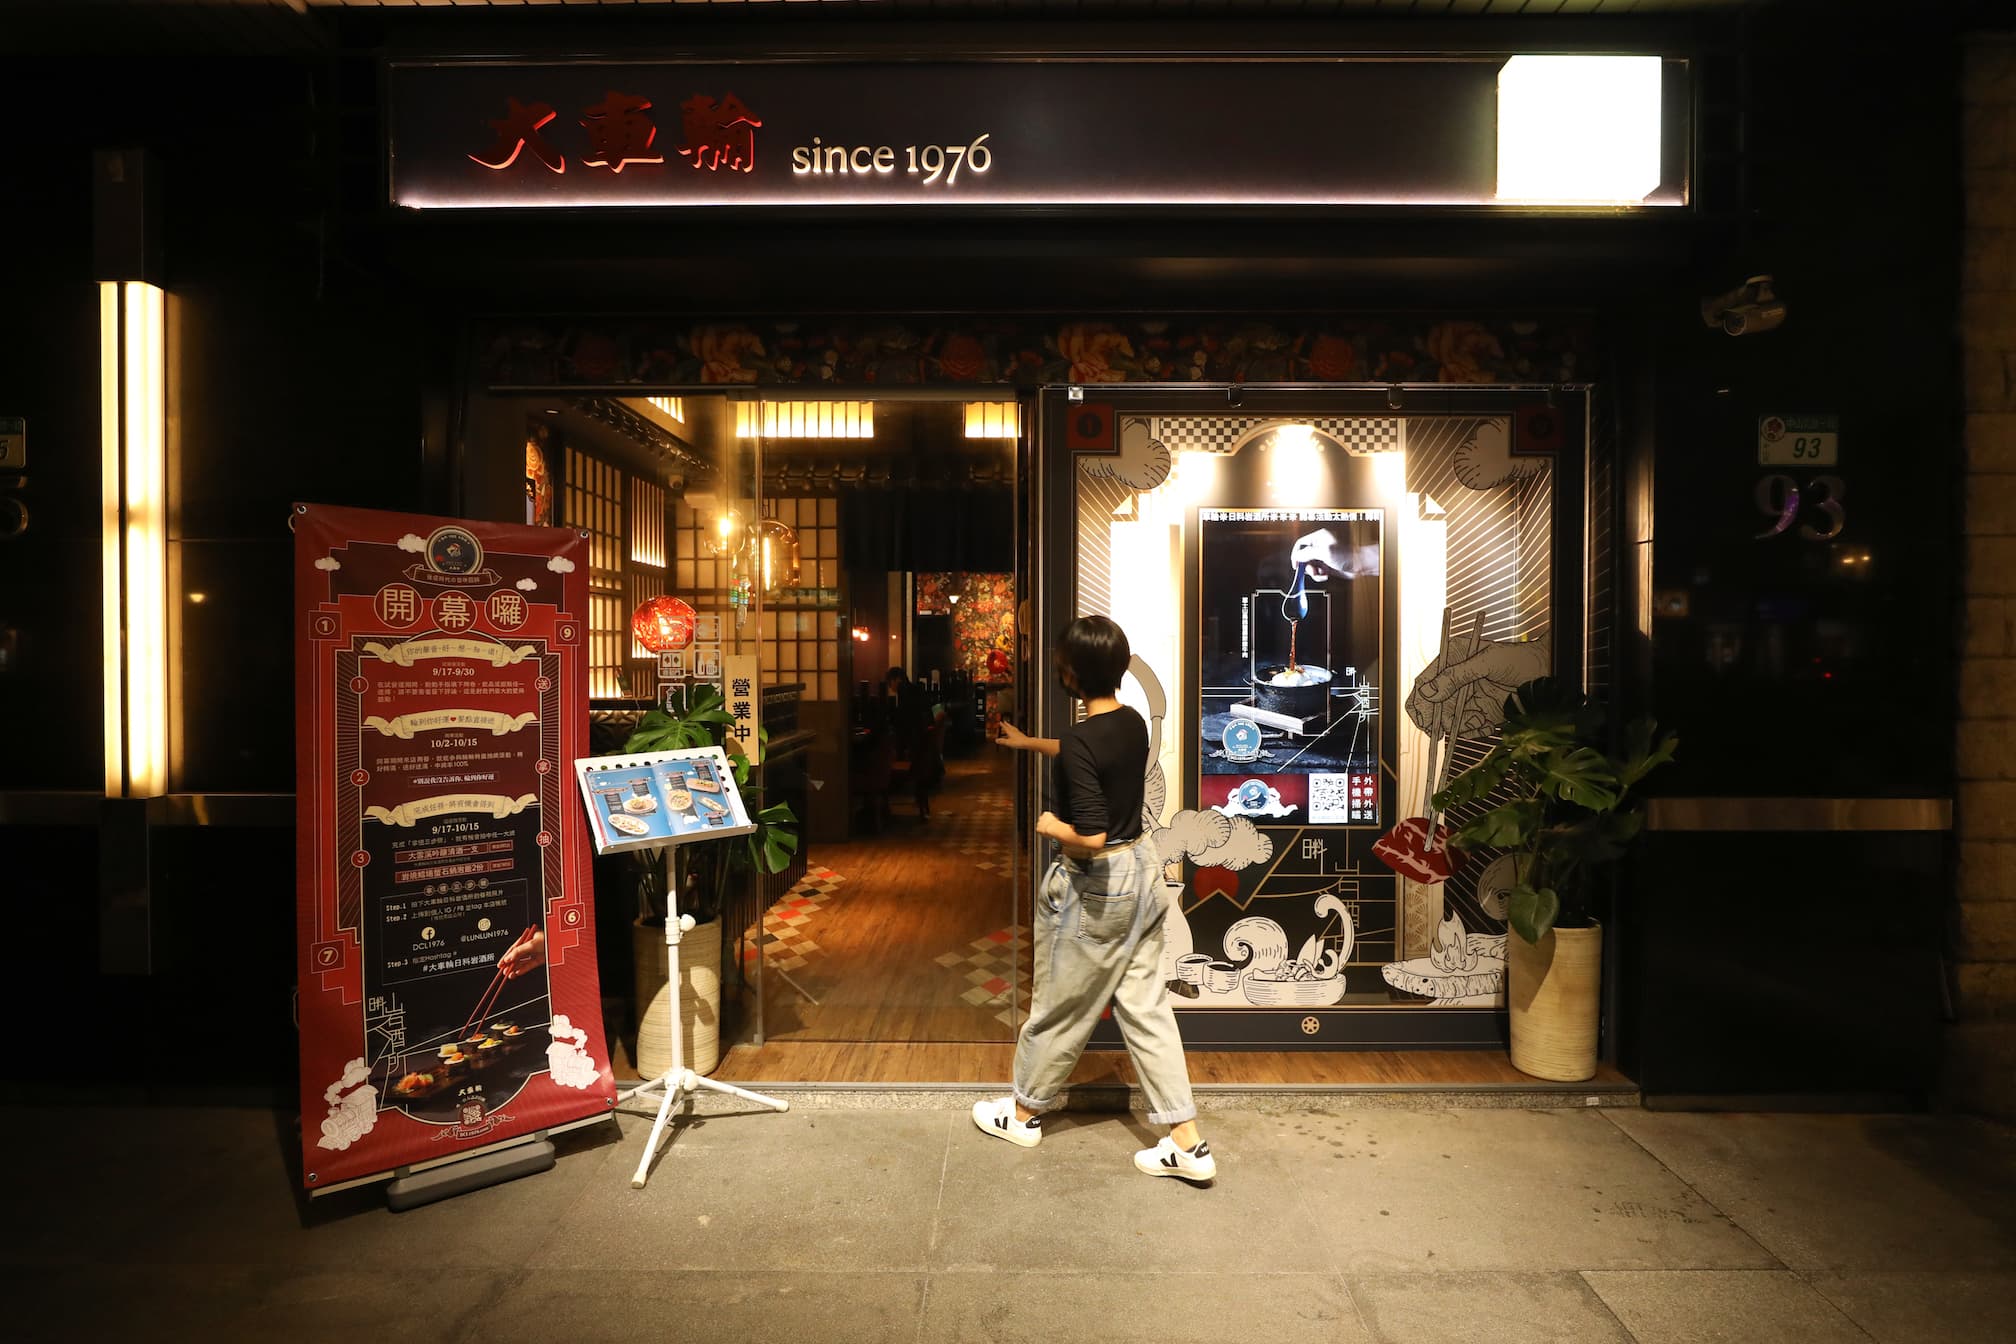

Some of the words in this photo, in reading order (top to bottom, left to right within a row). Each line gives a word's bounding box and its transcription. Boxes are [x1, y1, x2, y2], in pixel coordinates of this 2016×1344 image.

[466, 91, 762, 174] 大車輪
[792, 136, 895, 175] since
[906, 133, 991, 184] 1976
[1793, 437, 1821, 458] 93
[1754, 474, 1845, 540] 93
[383, 588, 523, 629] 開幕囉
[321, 620, 329, 632] 1
[563, 627, 572, 638] 9
[432, 667, 475, 677] 9/17-9/30
[732, 677, 751, 744] 營業中
[431, 738, 478, 748] 10/2-10/15
[1363, 775, 1374, 820] 外帶外送
[432, 822, 479, 834] 9/17-10/15
[539, 834, 550, 845] 抽
[413, 940, 446, 951] DCL1976
[323, 949, 334, 963] 7
